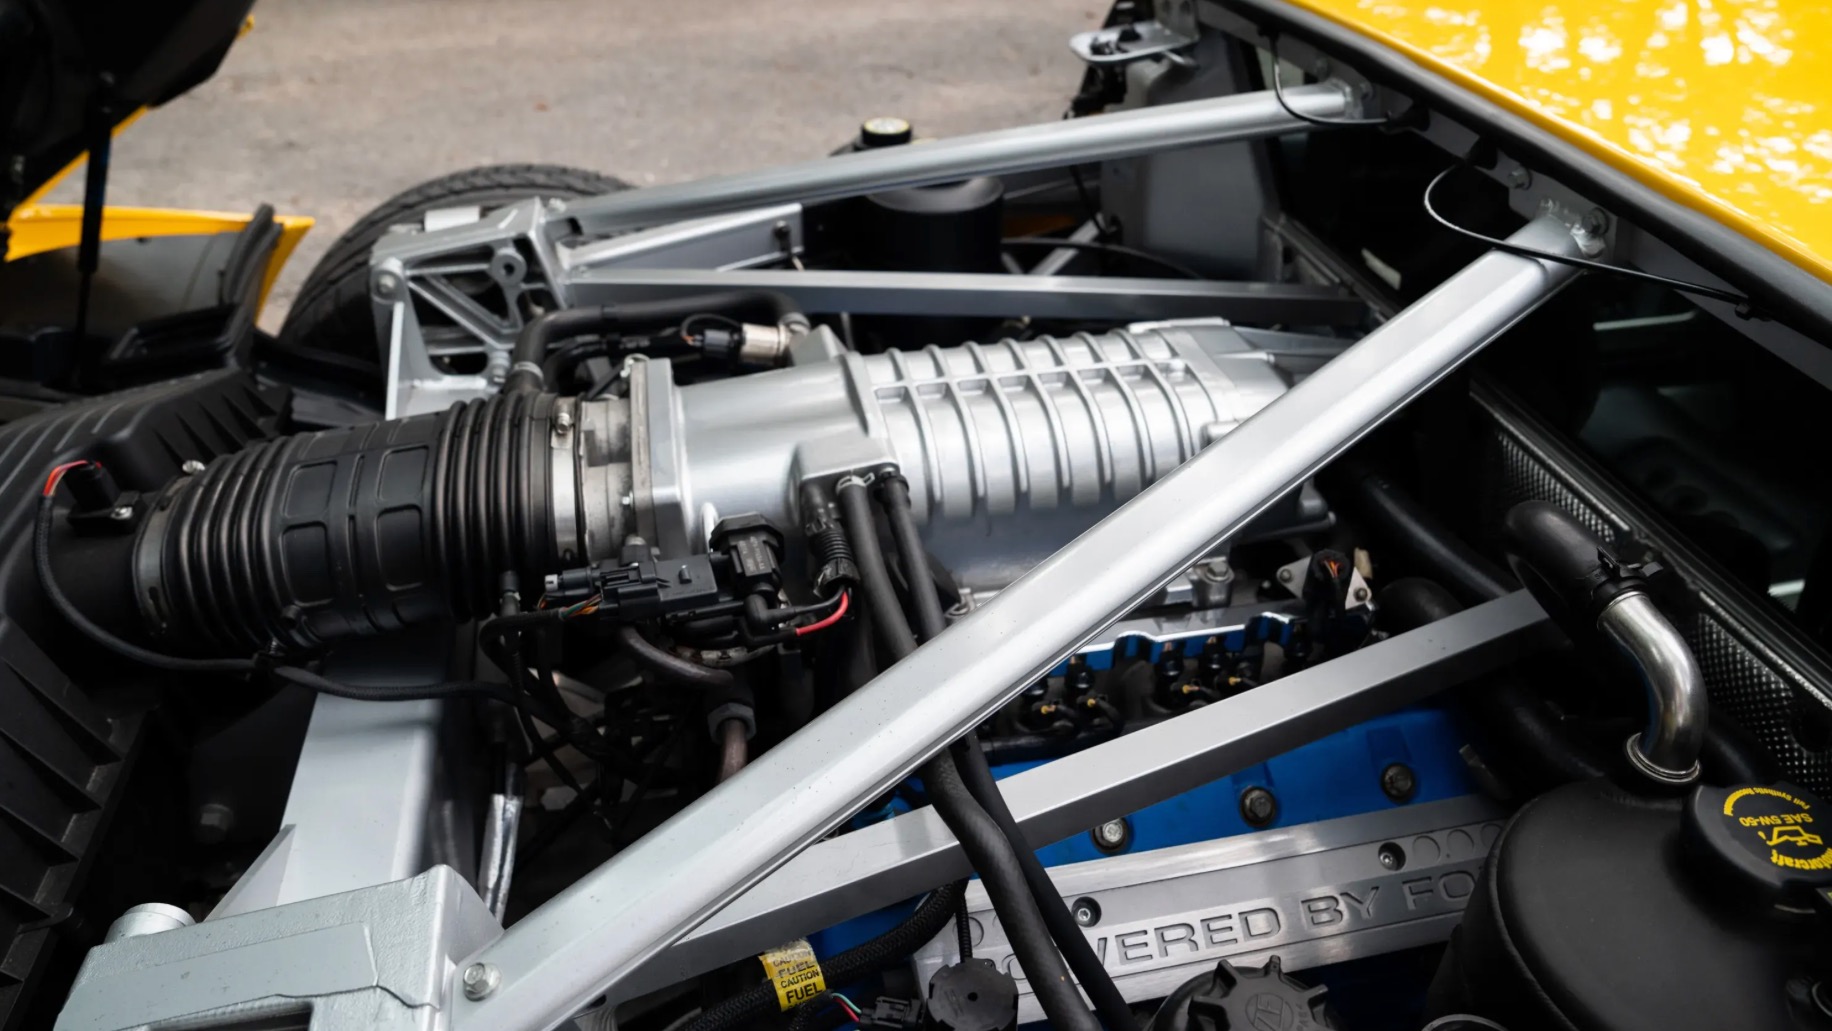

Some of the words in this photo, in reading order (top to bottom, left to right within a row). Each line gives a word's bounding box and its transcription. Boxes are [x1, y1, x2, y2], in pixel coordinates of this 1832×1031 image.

[1739, 815, 1781, 826] 5W-50
[1781, 813, 1813, 823] SAE
[1770, 848, 1832, 870] otorcraft
[1300, 885, 1380, 930] BY
[1401, 870, 1476, 911] FO
[777, 961, 815, 978] FUEL
[780, 969, 820, 989] CAUTION
[786, 982, 823, 1003] FUEL
